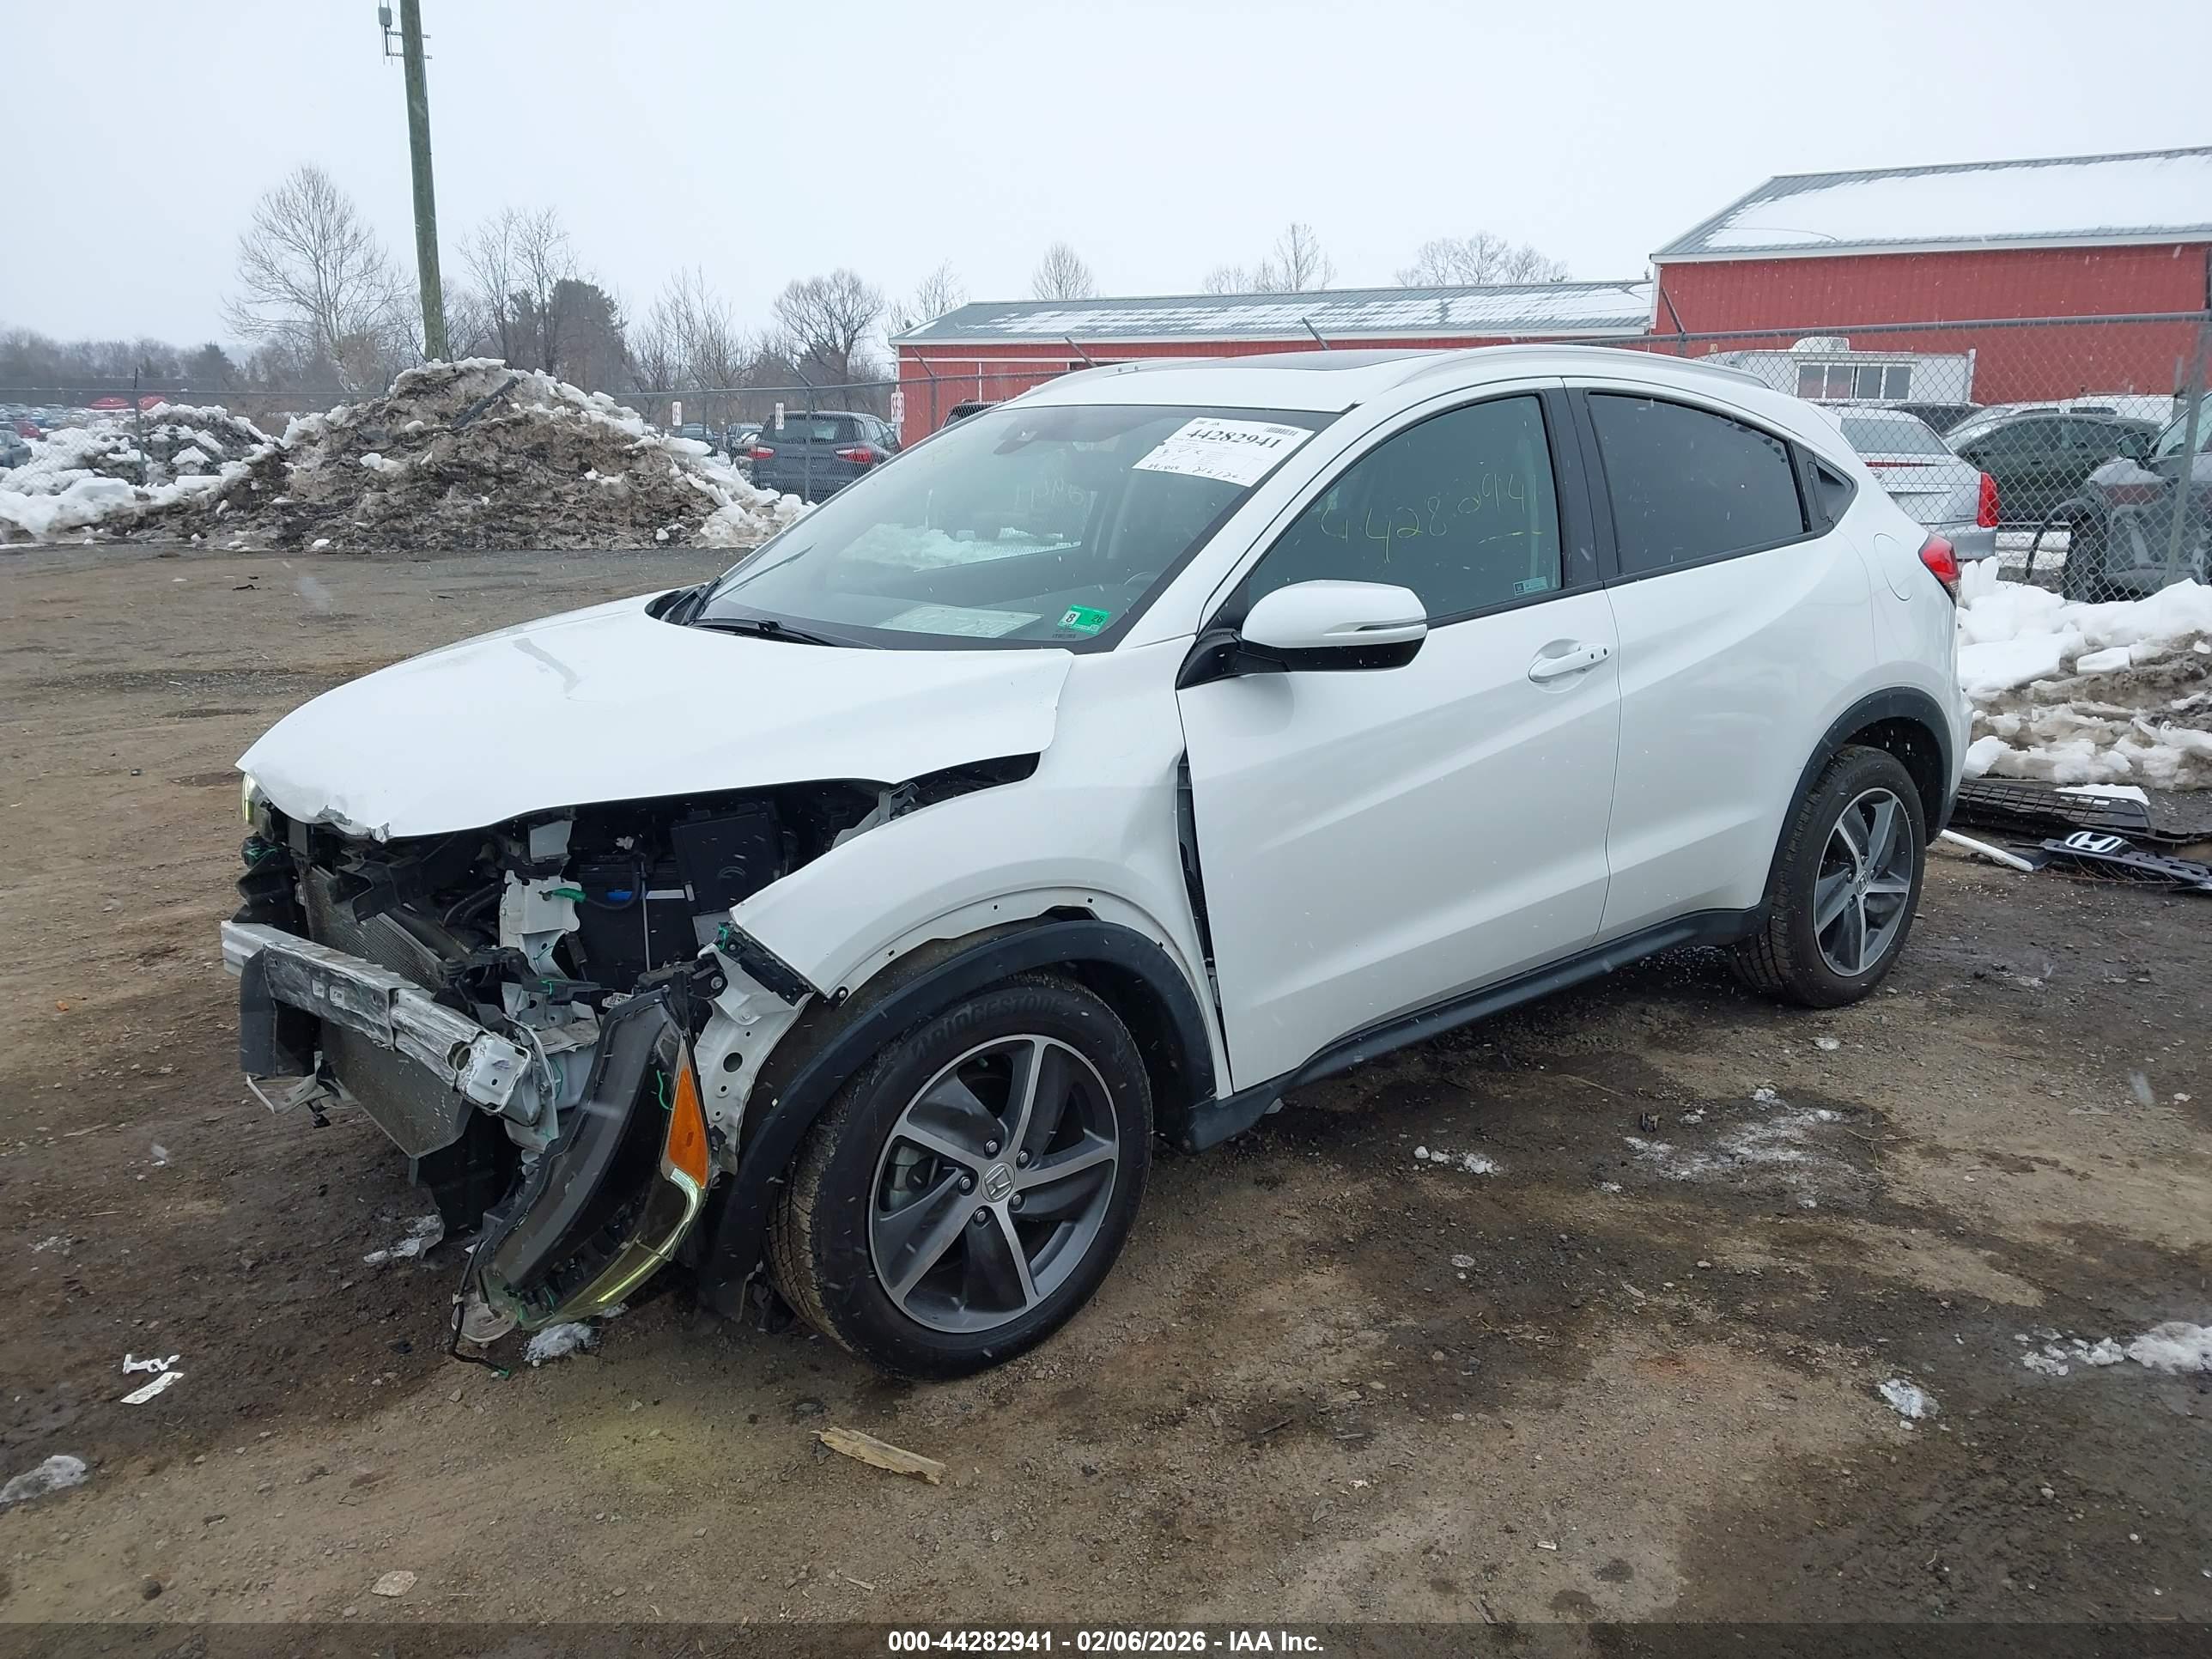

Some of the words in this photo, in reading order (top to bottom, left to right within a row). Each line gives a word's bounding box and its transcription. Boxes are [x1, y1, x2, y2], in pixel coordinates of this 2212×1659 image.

[1187, 428, 1282, 449] 44282941
[1066, 613, 1077, 623] 8
[1091, 614, 1105, 623] 26
